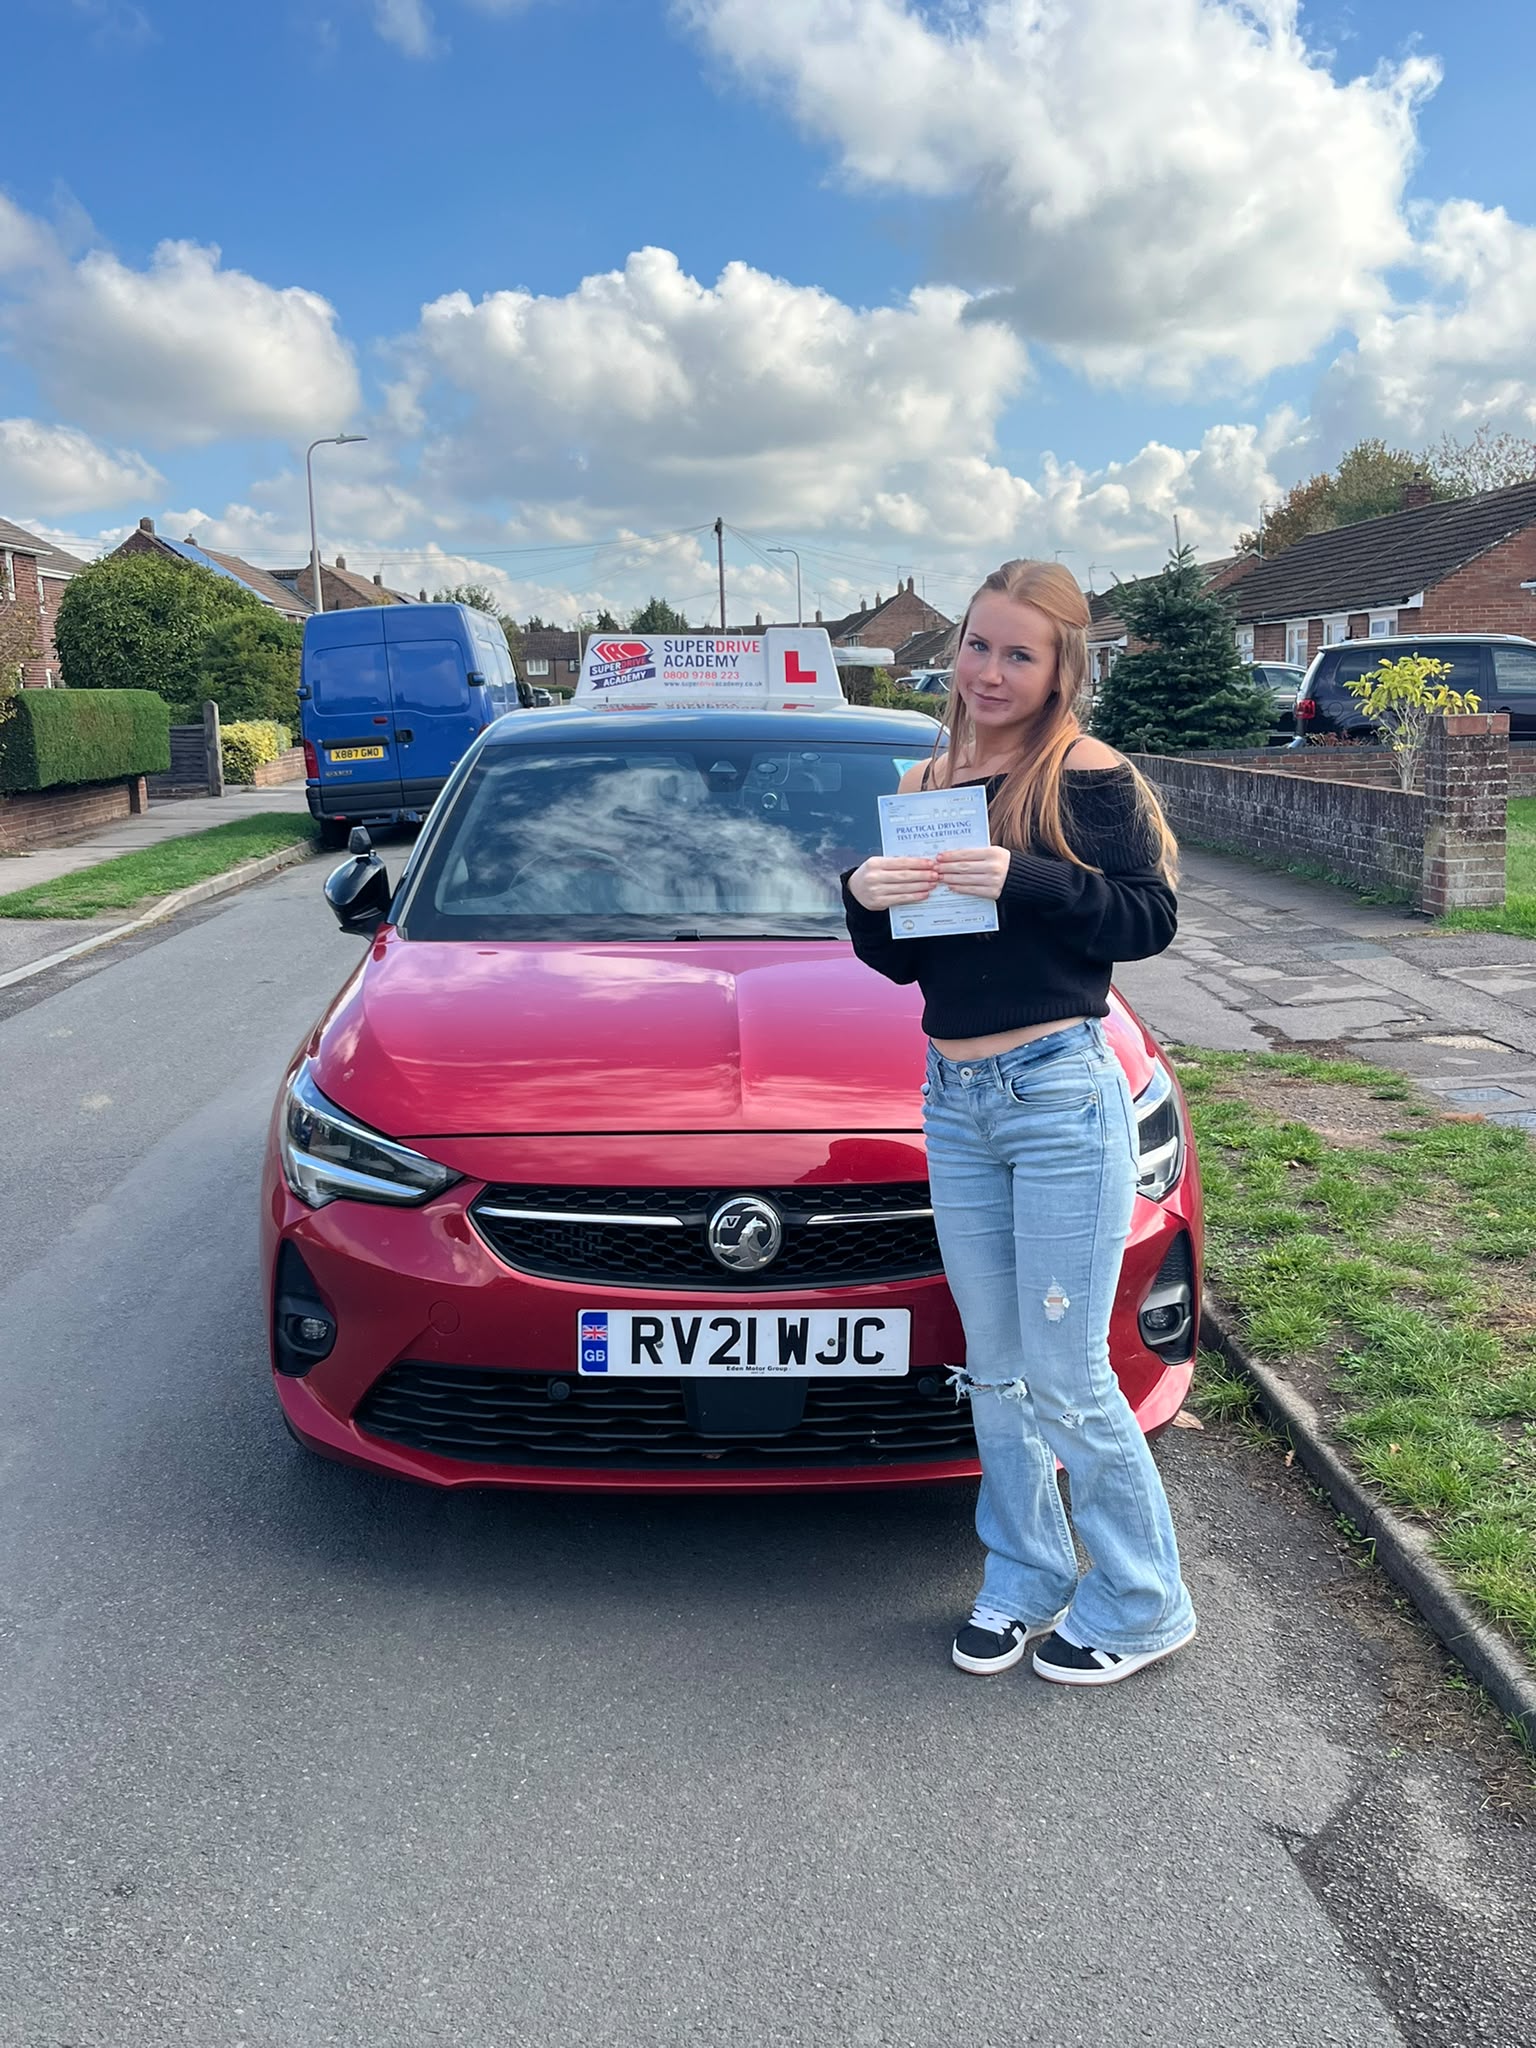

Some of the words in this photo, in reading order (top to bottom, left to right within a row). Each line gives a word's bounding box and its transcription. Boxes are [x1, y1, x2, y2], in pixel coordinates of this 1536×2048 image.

[664, 639, 760, 653] SUPERDRIVE
[591, 657, 646, 675] SUPERDRIVE
[664, 655, 739, 668] ACADEMY
[784, 650, 817, 683] L
[603, 671, 646, 687] ACADEMY
[663, 671, 689, 680] 0800
[692, 671, 718, 680] 9788
[720, 671, 740, 680] 223
[335, 749, 359, 759] X887
[896, 824, 935, 834] PRACTICAL
[937, 820, 972, 830] DRIVING
[930, 828, 972, 837] CERTIFICATE
[631, 1316, 757, 1365] RV21
[777, 1316, 885, 1365] WJC
[584, 1350, 606, 1362] GB
